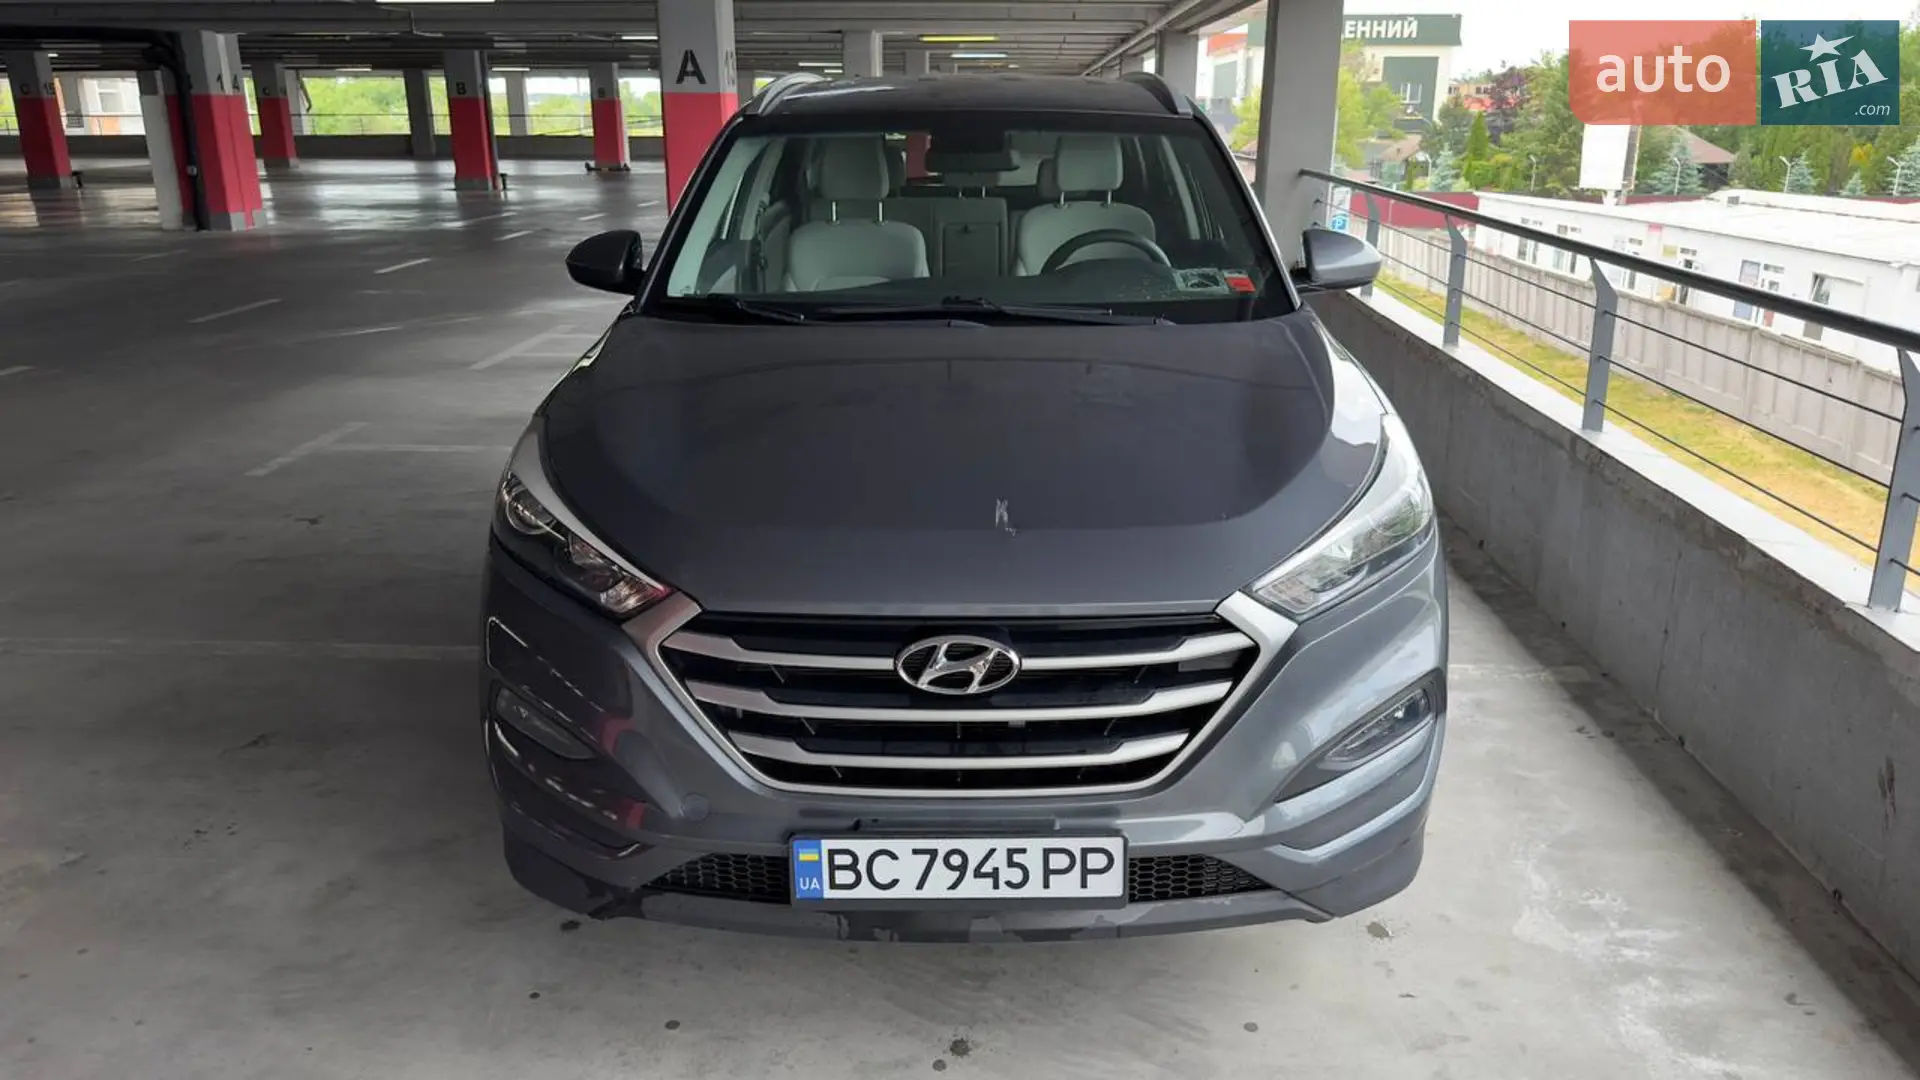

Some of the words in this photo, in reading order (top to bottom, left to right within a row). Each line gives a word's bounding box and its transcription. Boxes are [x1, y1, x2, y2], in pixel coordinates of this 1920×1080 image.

[1343, 16, 1419, 39] ЕННИЙ
[675, 49, 707, 85] A
[455, 82, 467, 96] B
[826, 848, 901, 891] BC
[910, 847, 1031, 891] 7945
[1042, 846, 1116, 890] PP
[799, 876, 821, 891] UA
